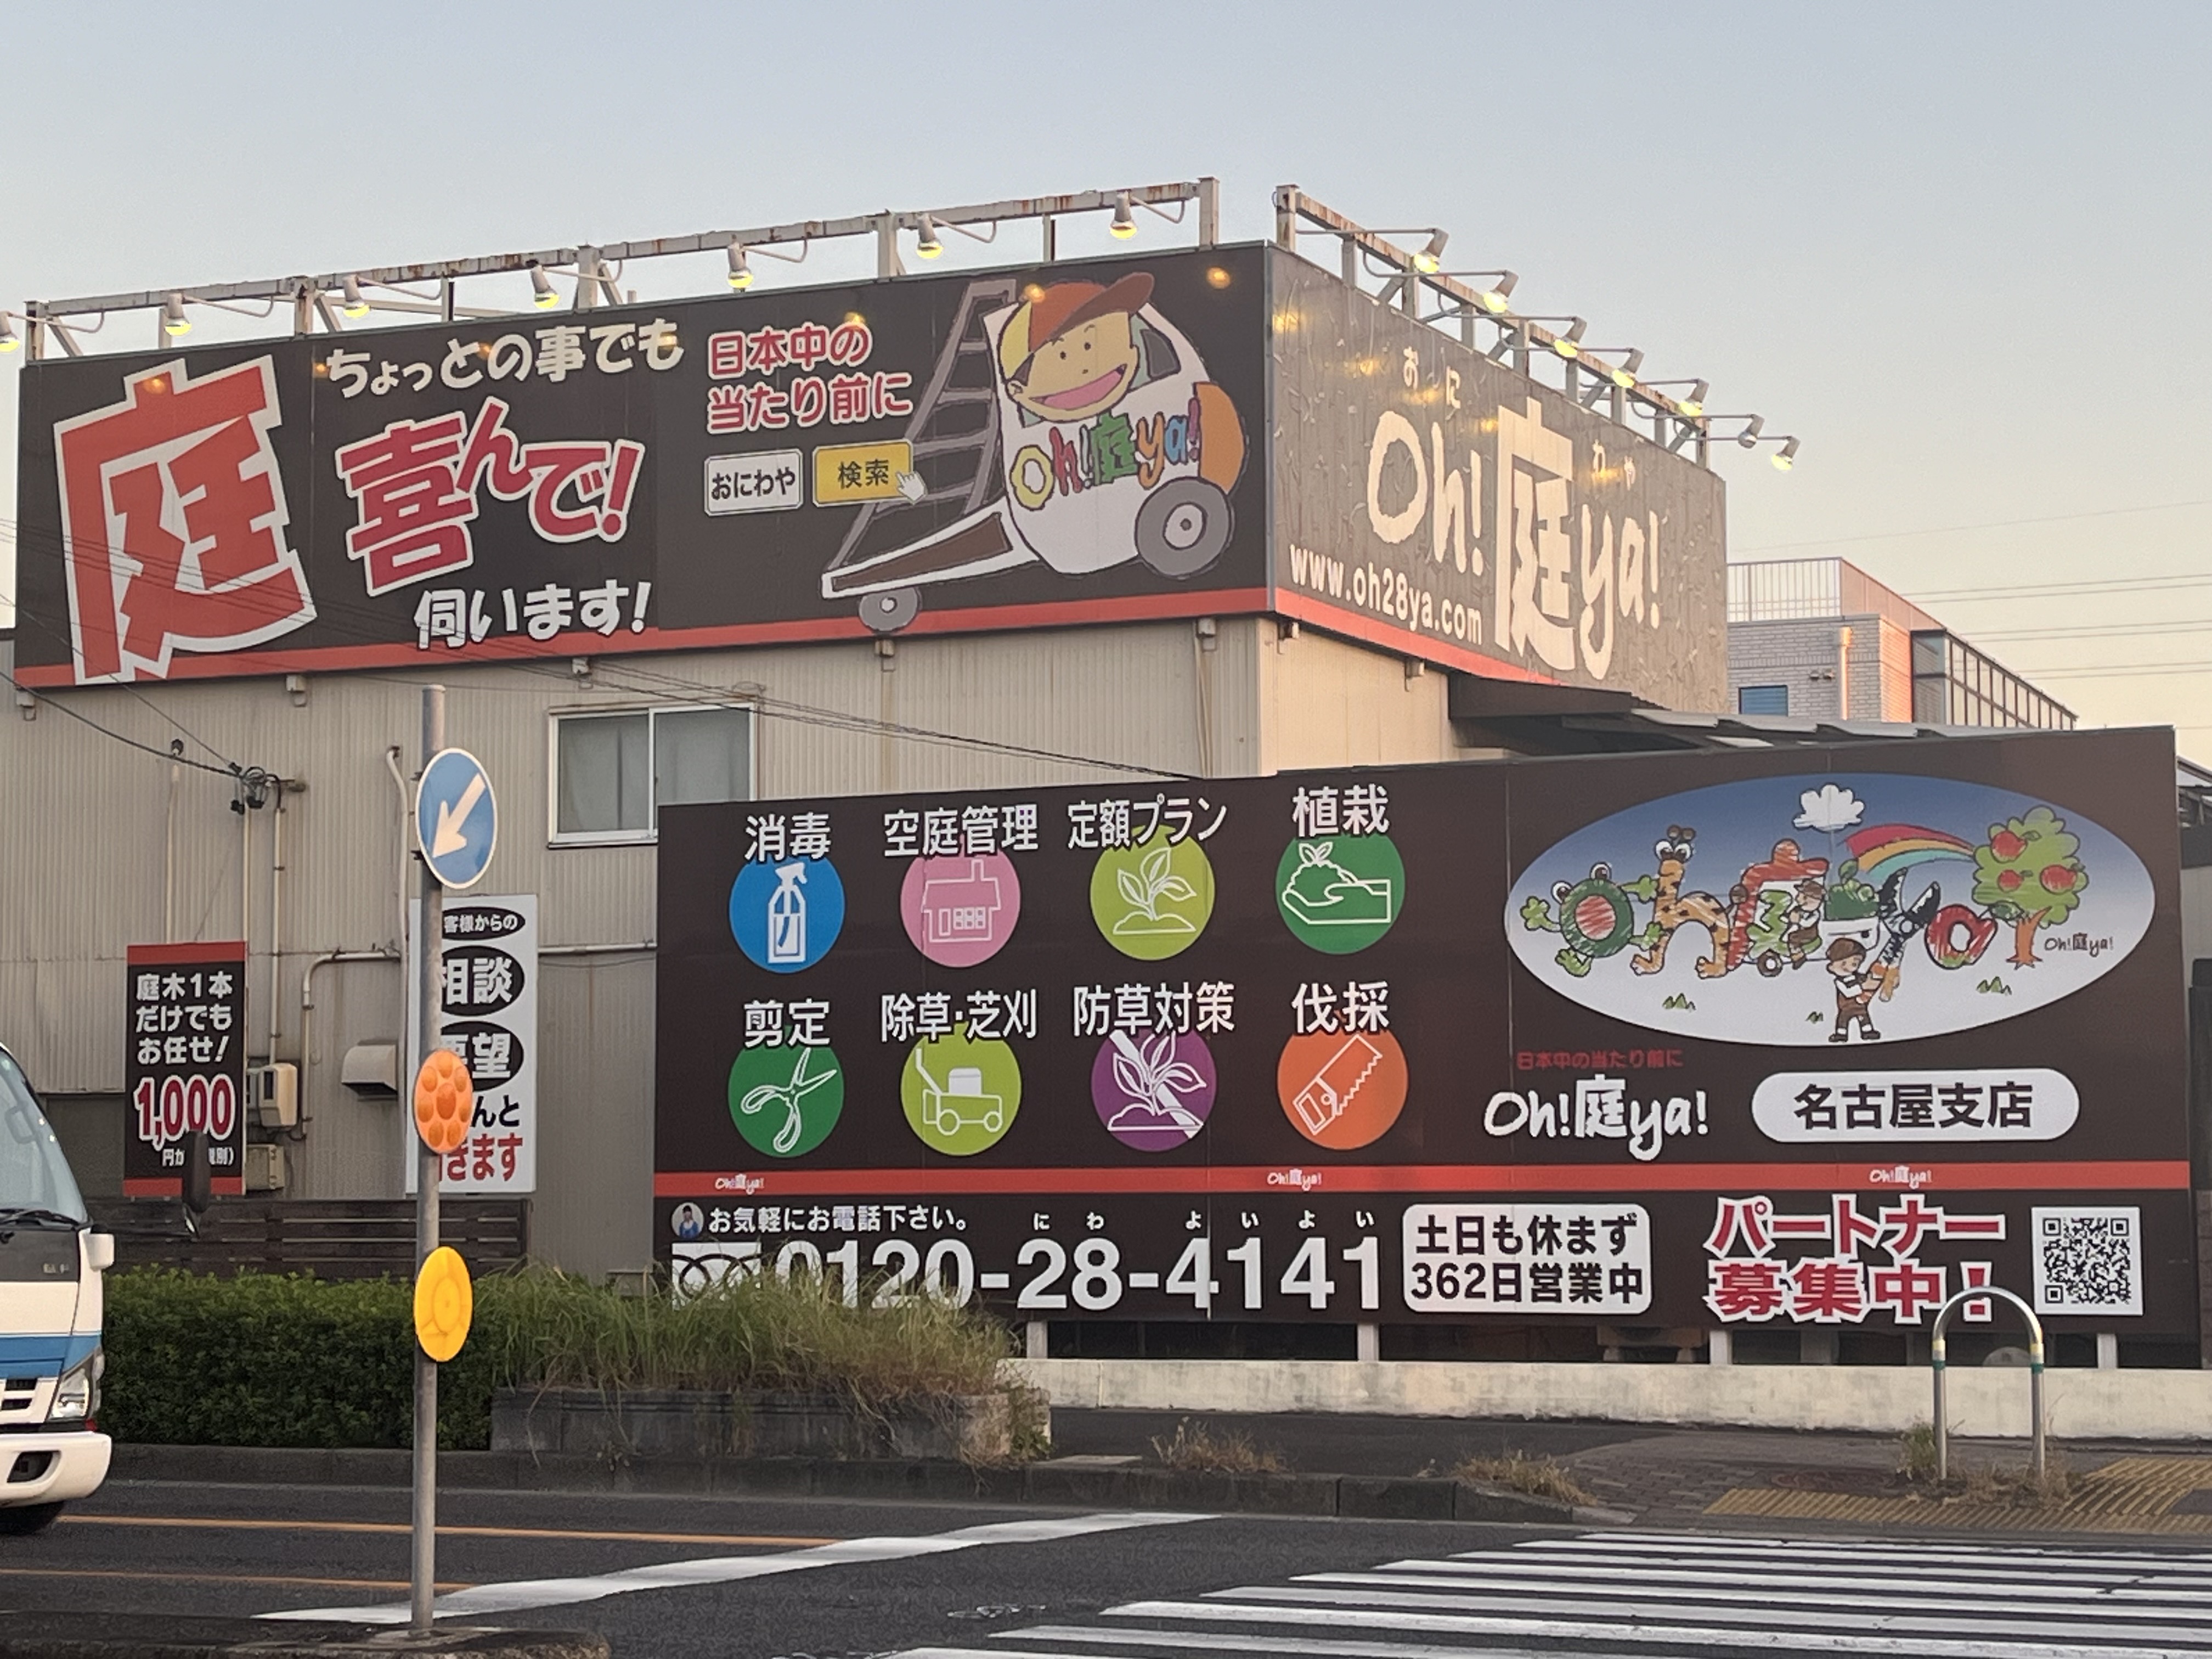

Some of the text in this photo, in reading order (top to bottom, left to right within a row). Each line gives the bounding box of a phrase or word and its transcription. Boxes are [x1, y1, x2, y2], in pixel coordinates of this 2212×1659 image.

[326, 318, 684, 398] ちょっとの事でも
[708, 321, 872, 379] 日本中の
[707, 372, 912, 433] 当たり前に
[335, 396, 645, 596] 喜んで!
[711, 466, 795, 500] おにわや
[838, 459, 889, 489] 検索
[54, 354, 317, 685] 庭
[415, 579, 652, 649] 伺います!
[1289, 544, 1482, 644] www.oh28ya.com
[744, 812, 832, 862] 消毒
[883, 804, 1039, 857] 空庭管理
[1067, 793, 1227, 850] 定額プラン
[1292, 783, 1389, 838] 植栽
[443, 914, 518, 933] 客様からの
[137, 970, 233, 1001] 庭木1本
[1073, 981, 1235, 1036] 防草対策
[1291, 980, 1389, 1034] 伐採
[136, 1003, 232, 1033] だけでも
[744, 998, 830, 1048] 剪定
[137, 1035, 230, 1065] お任せ!
[1516, 1049, 1684, 1070] 日本中の当たり前に
[133, 1074, 236, 1151] 1,000
[1483, 1073, 1709, 1161] Oh!庭ya!
[1793, 1081, 2033, 1130] 名古屋支店
[708, 1204, 967, 1234] お気軽にお電話下さい。
[1416, 1212, 1638, 1256] 土日も休まず
[1703, 1193, 2006, 1260] パートナー
[1411, 1262, 1643, 1304] 362日営業中
[1702, 1257, 1992, 1324] 募集中!
